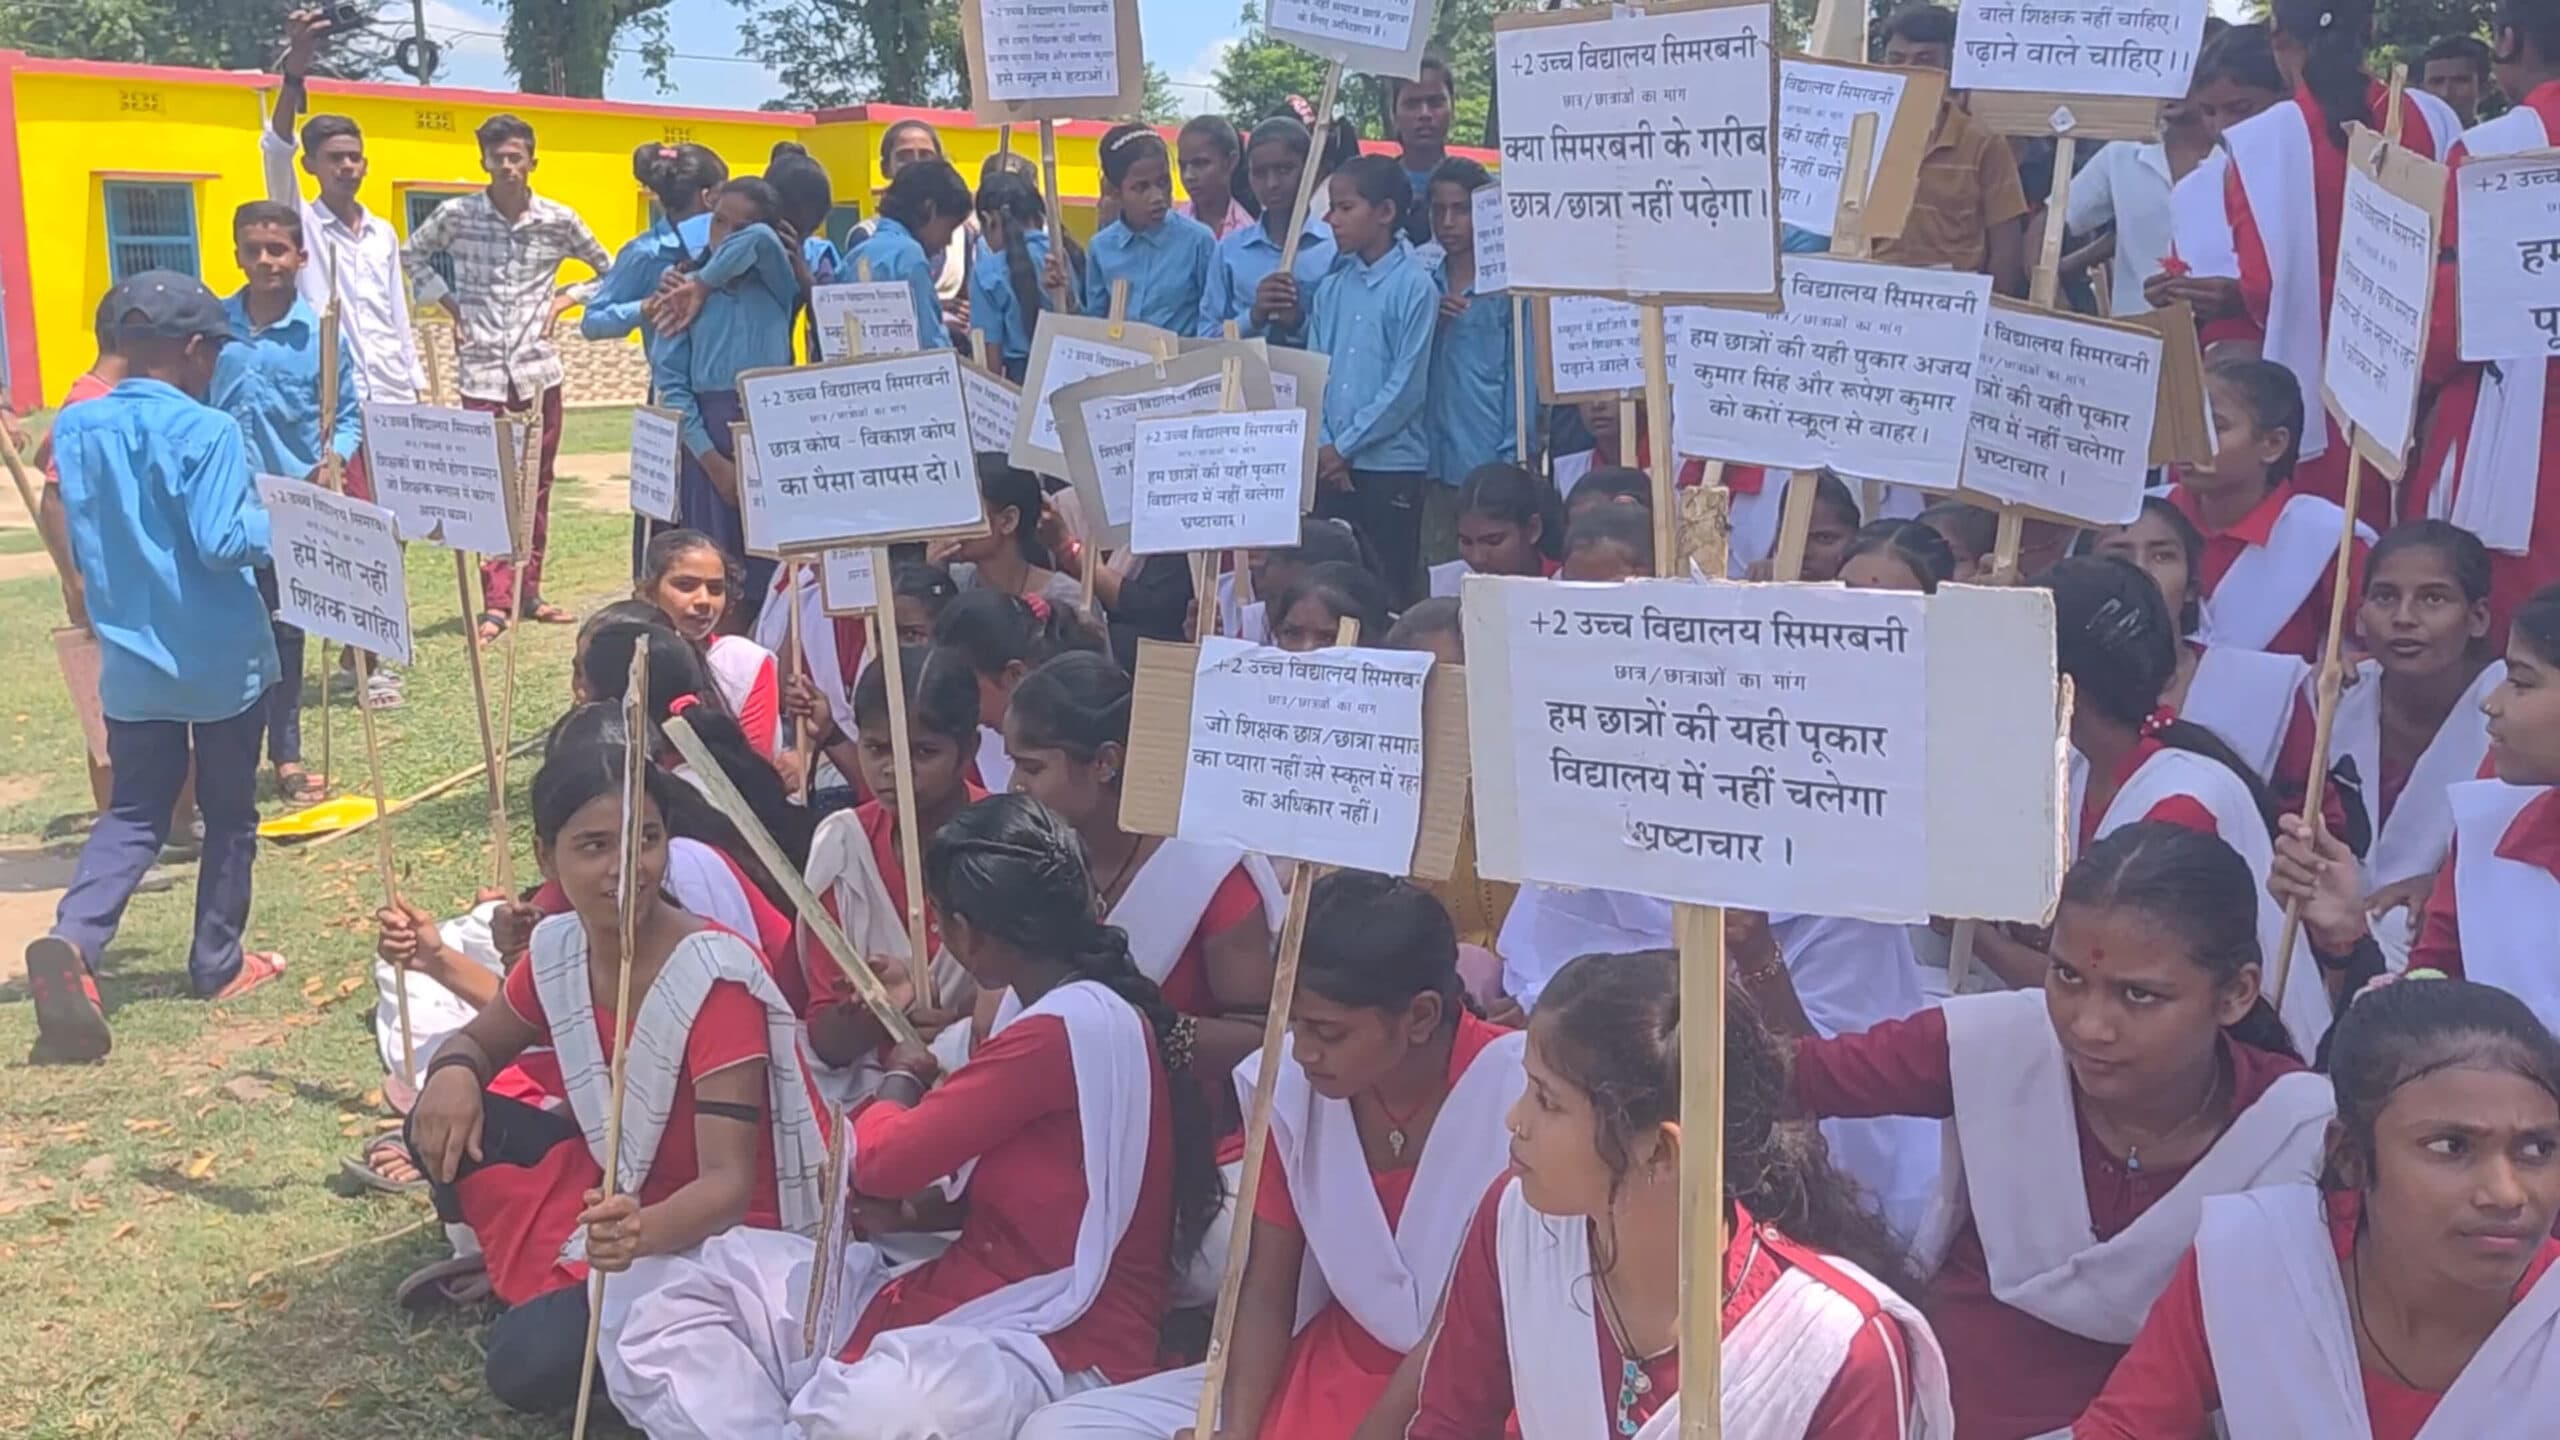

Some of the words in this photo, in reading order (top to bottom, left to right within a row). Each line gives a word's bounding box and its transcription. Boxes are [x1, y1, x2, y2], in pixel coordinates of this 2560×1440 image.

[1979, 4, 2013, 24] वाले
[2020, 6, 2075, 26] शिक्षक
[2080, 6, 2112, 30] नहीं
[1511, 53, 1535, 77] +2
[1537, 49, 1574, 73] उच्च
[1578, 41, 1658, 71] विद्यालय
[1662, 25, 1758, 65] सिमरबनी
[2026, 34, 2081, 67] वाले
[1640, 89, 1658, 104] का
[1784, 72, 1836, 94] विद्यालय
[1503, 135, 1546, 162] क्या
[1550, 119, 1656, 163] सिमरबनी
[1660, 116, 1692, 158] के
[1697, 114, 1768, 159] गरीब
[1789, 155, 1817, 178] नहीं
[2476, 174, 2510, 192] +2
[1628, 178, 1673, 223] नहीं
[1791, 272, 1878, 302] विद्यालय
[1884, 281, 1978, 315] सिमरबनी
[869, 318, 914, 339] राजनीति
[1689, 327, 1718, 349] हम
[1723, 327, 1772, 356] छात्रों
[1776, 333, 1807, 360] की
[1810, 338, 1848, 365] यही
[1912, 354, 1972, 379] अजय
[1994, 320, 2065, 355] विद्यालय
[2069, 337, 2151, 376] सिमरबनी
[759, 391, 783, 409] +2
[784, 385, 818, 404] उच्च
[820, 379, 882, 401] विद्यालय
[885, 365, 951, 392] सिमरबनी
[1692, 362, 1747, 390] कुमार
[1752, 365, 1791, 393] सिंह
[1796, 369, 1835, 398] और
[1839, 376, 1893, 406] रूपेश
[1898, 394, 1957, 416] कुमार
[2006, 383, 2032, 408] की
[2036, 393, 2074, 418] यही
[1144, 431, 1163, 446] +2
[1164, 429, 1189, 442] उच्च
[1191, 425, 1240, 442] विद्यालय
[1708, 394, 1738, 418] को
[1742, 399, 1782, 423] करों
[1785, 408, 1838, 442] स्कूल
[1844, 410, 1865, 437] से
[768, 440, 801, 459] छात्र
[2005, 415, 2022, 441] में
[2026, 425, 2062, 451] नहीं
[2064, 434, 2126, 467] चलेगा
[778, 476, 808, 498] का
[811, 465, 856, 495] पैसा
[860, 463, 920, 489] वापस
[1148, 470, 1165, 484] हम
[1203, 462, 1221, 480] की
[1224, 460, 1249, 478] यही
[1974, 445, 2049, 482] भ्रष्टाचार
[1146, 489, 1198, 509] विद्यालय
[1203, 487, 1215, 503] में
[1217, 484, 1240, 505] नहीं
[1243, 485, 1285, 503] चलेगा
[290, 534, 318, 569] हमें
[320, 541, 352, 582] नेता
[355, 560, 389, 597] नहीं
[289, 577, 346, 624] शिक्षक
[349, 605, 403, 654] चाहिए
[1529, 610, 1568, 638] +2
[1574, 609, 1633, 639] उच्च
[1640, 605, 1762, 647] विद्यालय
[1769, 611, 1909, 654] सिमरबनी
[1213, 657, 1242, 675] +2
[1248, 658, 1284, 676] उच्च
[1288, 657, 1357, 684] विद्यालय
[1737, 671, 1762, 691] का
[1771, 669, 1808, 692] मांग
[1336, 700, 1352, 714] का
[1204, 709, 1229, 734] जो
[1234, 713, 1290, 742] शिक्षक
[1545, 700, 1588, 734] हम
[1592, 696, 1667, 738] छात्रों
[1672, 699, 1720, 744] की
[1727, 705, 1791, 751] यही
[1795, 720, 1889, 764] पूकार
[1191, 748, 1220, 769] का
[1225, 753, 1265, 773] प्यारा
[1270, 755, 1301, 781] नहीं
[1329, 764, 1376, 793] स्कूल
[1378, 763, 1394, 790] में
[1549, 746, 1672, 797] विद्यालय
[1677, 757, 1705, 801] में
[1713, 765, 1776, 809] नहीं
[1783, 770, 1888, 818] चलेगा
[1241, 788, 1267, 810] का
[1270, 789, 1335, 818] अधिकार
[1632, 818, 1765, 865] भ्रष्टाचार
